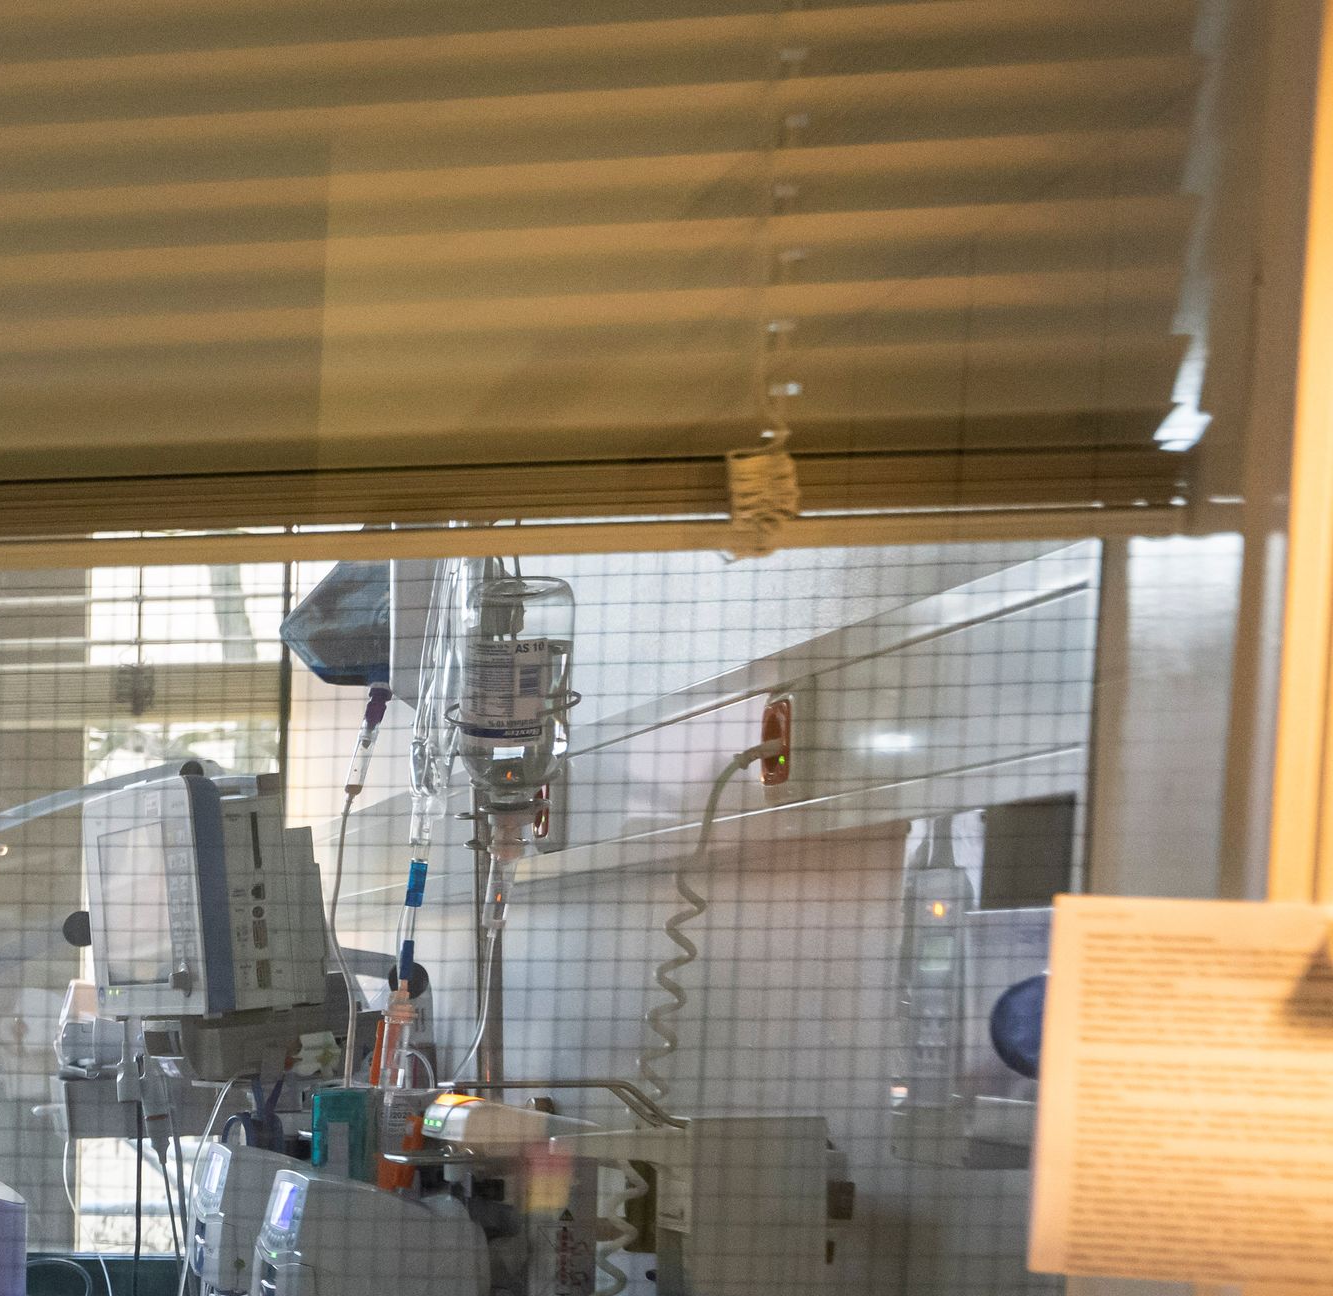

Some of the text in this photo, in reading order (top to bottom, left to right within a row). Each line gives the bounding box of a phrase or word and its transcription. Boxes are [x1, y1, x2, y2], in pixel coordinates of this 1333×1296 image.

[516, 643, 529, 653] AS
[533, 641, 544, 651] 10
[504, 728, 540, 736] Baxter
